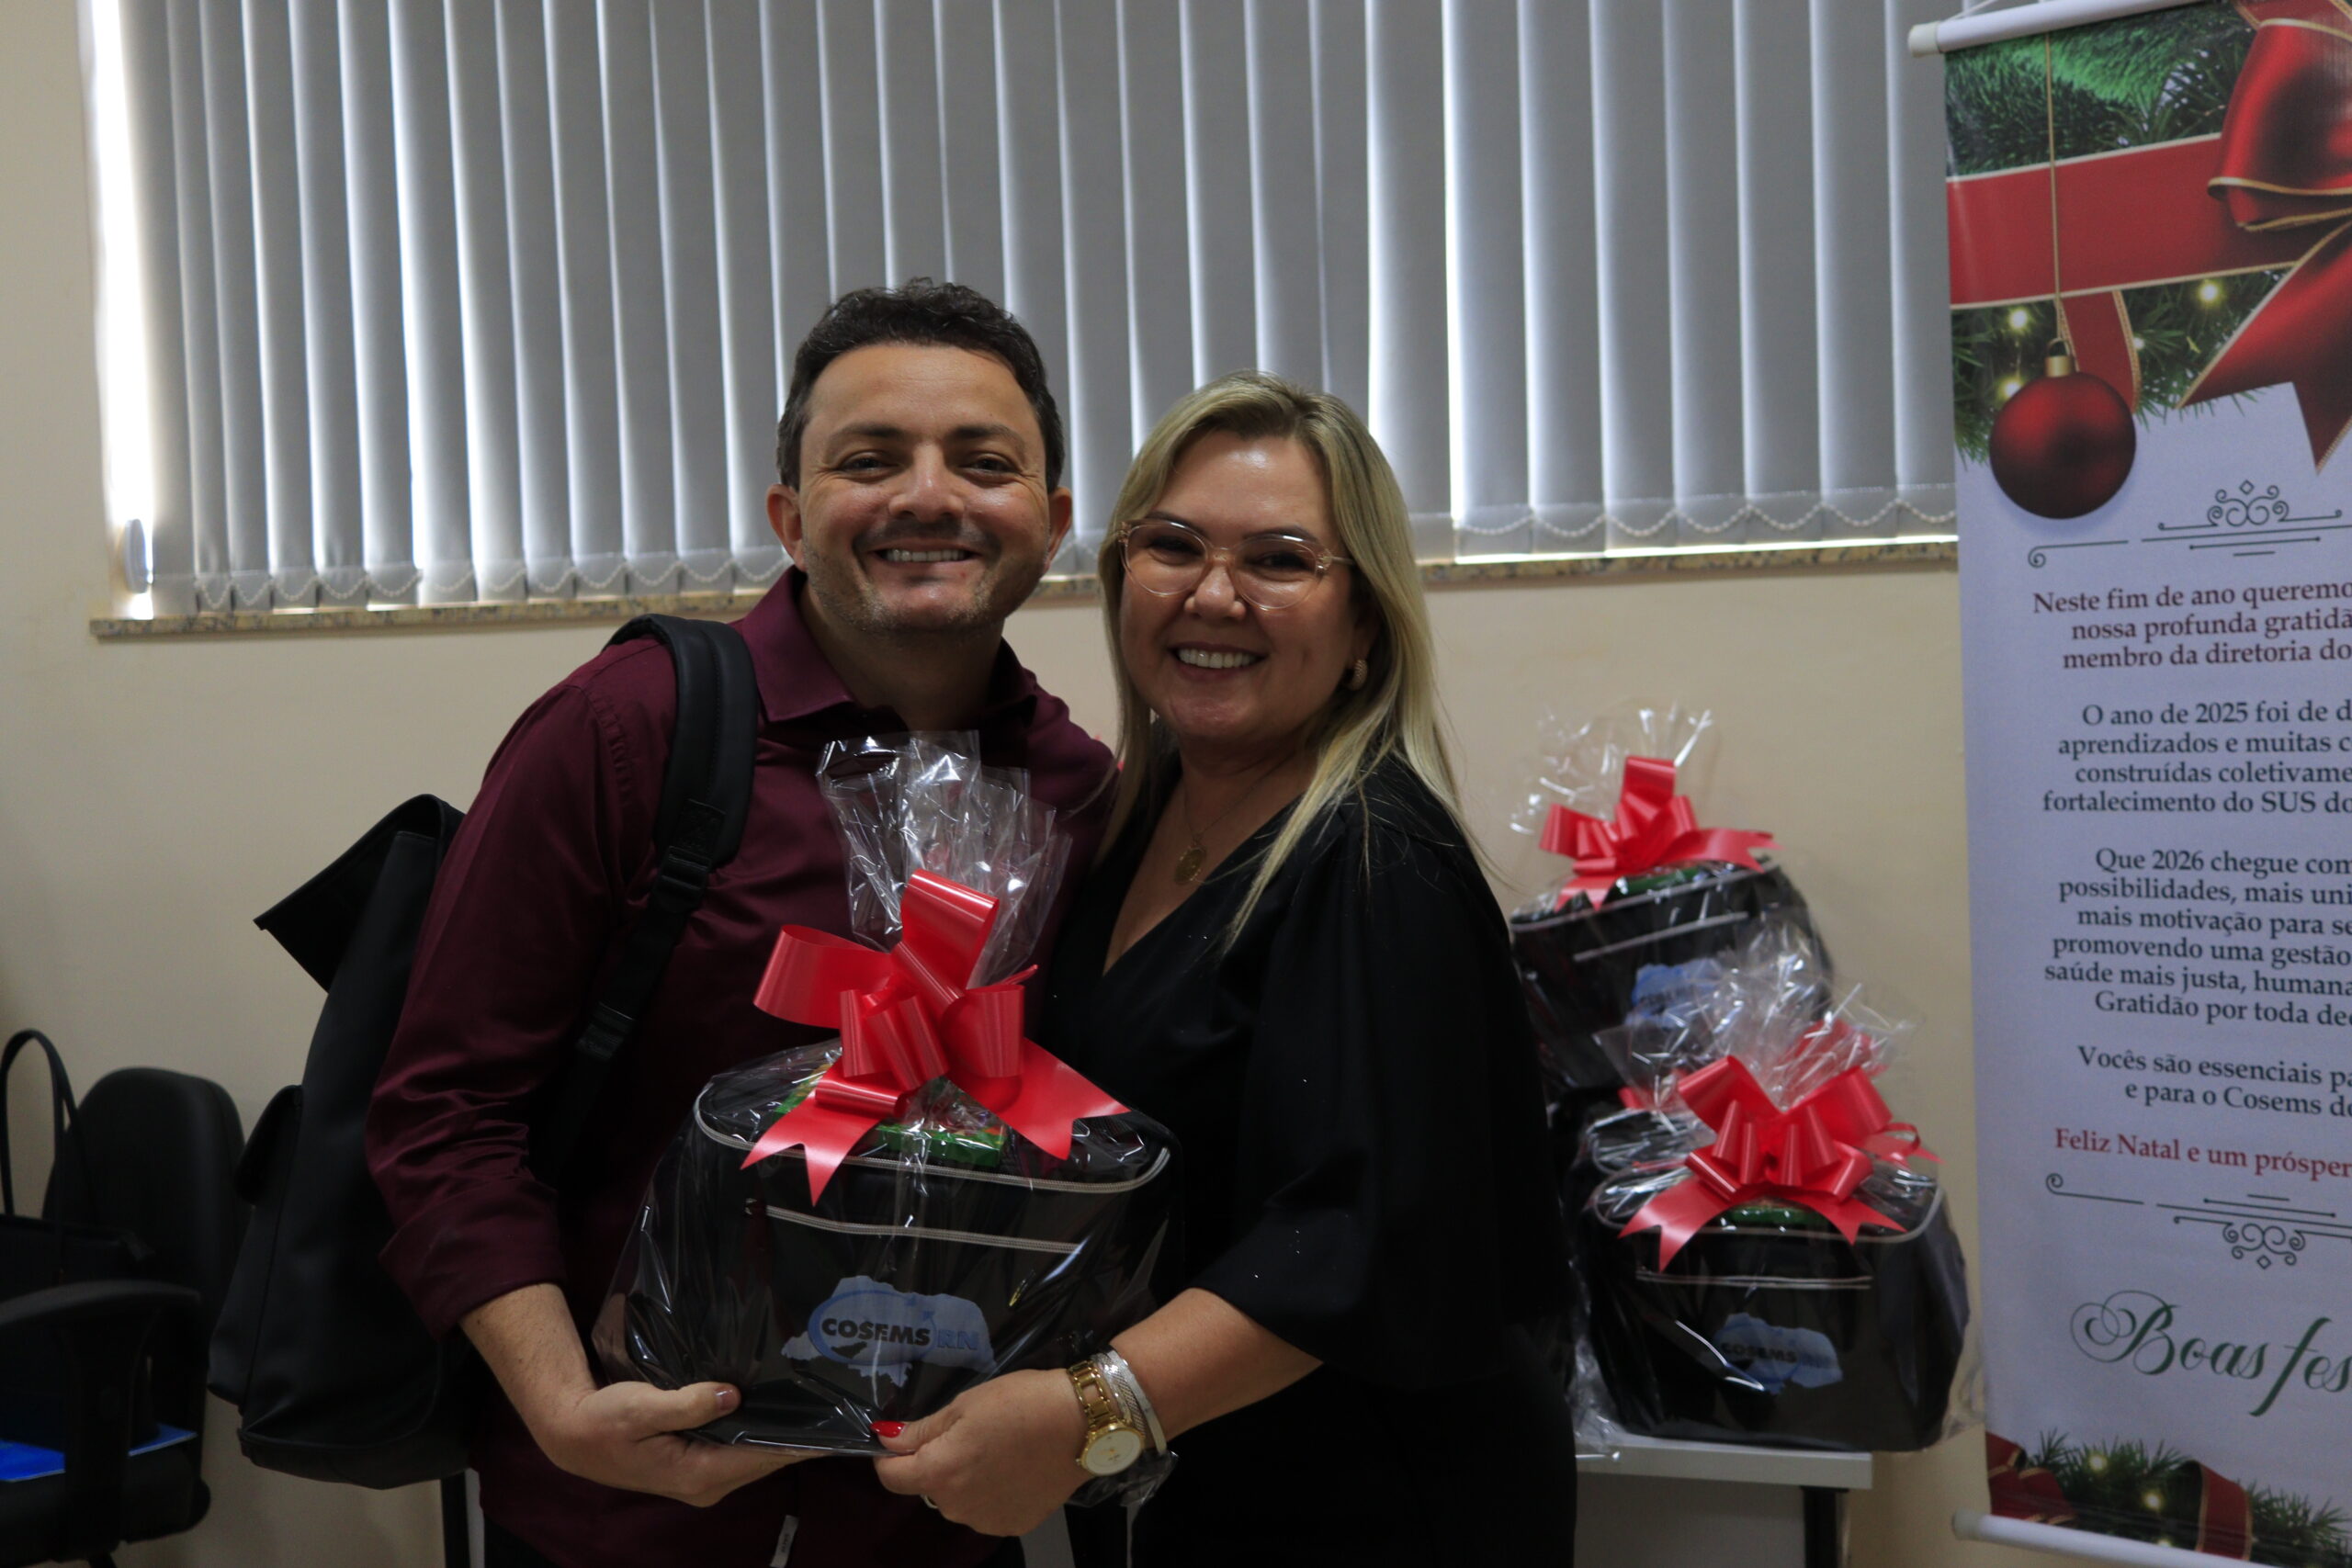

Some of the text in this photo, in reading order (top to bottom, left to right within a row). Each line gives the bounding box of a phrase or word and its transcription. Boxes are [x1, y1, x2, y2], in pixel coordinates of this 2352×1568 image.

[2033, 592, 2100, 614] Neste
[2107, 588, 2148, 609] fim
[2155, 585, 2184, 607] de
[2191, 587, 2235, 605] ano
[2072, 622, 2136, 639] nossa
[2144, 613, 2257, 643] profunda
[2063, 637, 2352, 669] membro da diretoria do
[2082, 705, 2103, 726] O
[2110, 707, 2153, 725] ano
[2161, 704, 2188, 724] de
[2196, 702, 2248, 724] 2025
[2256, 701, 2289, 723] foi
[2298, 700, 2328, 722] de
[2059, 732, 2219, 761] aprendizados
[2225, 736, 2239, 753] e
[2246, 732, 2331, 753] muitas
[2075, 761, 2211, 783] construídas
[2042, 791, 2216, 812] fortalecimento
[2223, 791, 2254, 812] do
[2261, 791, 2315, 814] SUS
[2096, 848, 2145, 872] Que
[2153, 850, 2204, 871] 2026
[2211, 851, 2299, 879] chegue
[2059, 877, 2237, 905] possibilidades,
[2245, 883, 2303, 904] mais
[2077, 907, 2132, 927] mais
[2140, 909, 2262, 935] motivação
[2270, 917, 2324, 940] para
[2053, 938, 2351, 969] promovendo uma gestão
[2045, 962, 2112, 982] saúde
[2120, 966, 2175, 987] mais
[2182, 967, 2246, 993] justa,
[2095, 990, 2352, 1027] Gratidão por toda de
[2077, 1046, 2146, 1070] Vocês
[2154, 1054, 2191, 1074] são
[2199, 1061, 2322, 1085] essenciais
[2125, 1083, 2137, 1099] e
[2144, 1084, 2196, 1106] para
[2203, 1089, 2216, 1105] o
[2223, 1087, 2322, 1115] Cosems
[2055, 1128, 2109, 1153] Feliz
[2118, 1134, 2180, 1160] Natal
[2188, 1147, 2199, 1162] e
[2208, 1148, 2246, 1168] um
[821, 1317, 931, 1346] COSEMS
[2070, 1290, 2270, 1380] Boas
